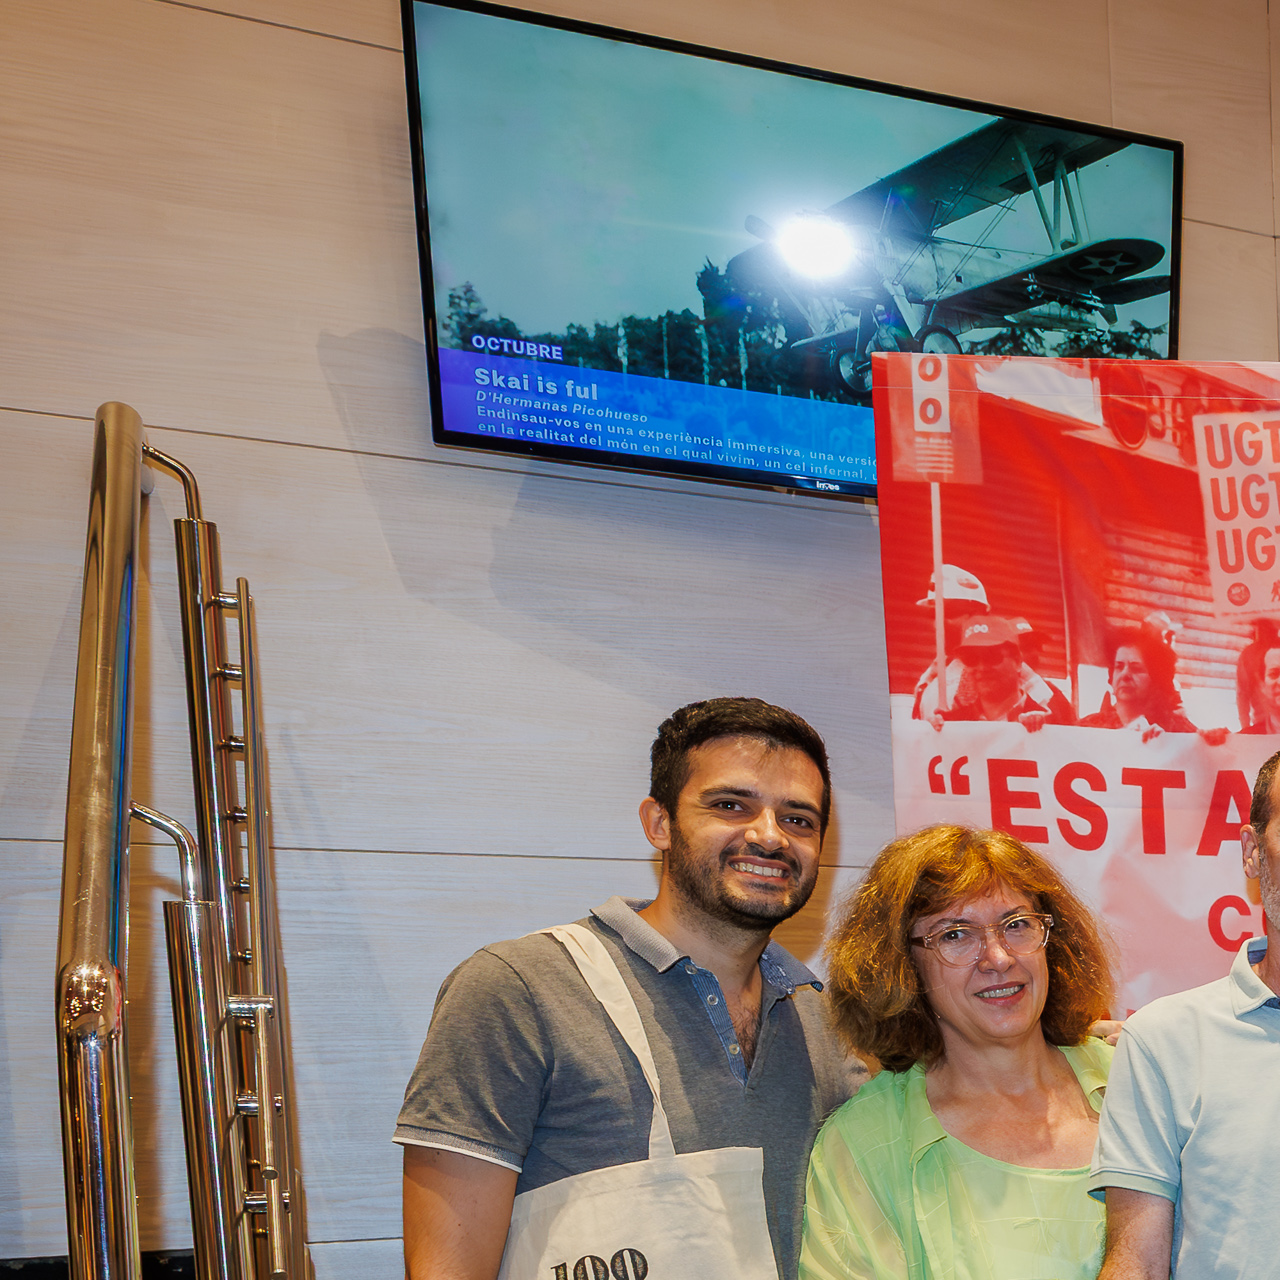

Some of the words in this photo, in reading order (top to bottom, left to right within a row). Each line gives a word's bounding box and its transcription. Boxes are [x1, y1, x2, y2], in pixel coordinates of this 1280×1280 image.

[472, 334, 563, 361] OCTUBRE
[474, 368, 530, 391] Skai
[537, 376, 558, 395] is
[565, 380, 598, 400] ful
[476, 390, 568, 413] D'Hermanas
[572, 403, 648, 423] Picohueso
[477, 405, 580, 429] Endinsau-vos
[585, 421, 602, 432] en
[607, 424, 634, 436] una
[638, 429, 723, 447] experiència
[728, 438, 805, 459] immersiva,
[810, 451, 834, 461] una
[478, 423, 496, 433] en
[501, 422, 514, 435] la
[519, 429, 575, 443] realitat
[579, 434, 602, 446] del
[607, 438, 638, 451] món
[643, 444, 660, 453] en
[665, 445, 677, 456] el
[682, 449, 712, 460] qual
[717, 452, 760, 467] vivim,
[764, 459, 781, 468] un
[786, 462, 806, 472] cel
